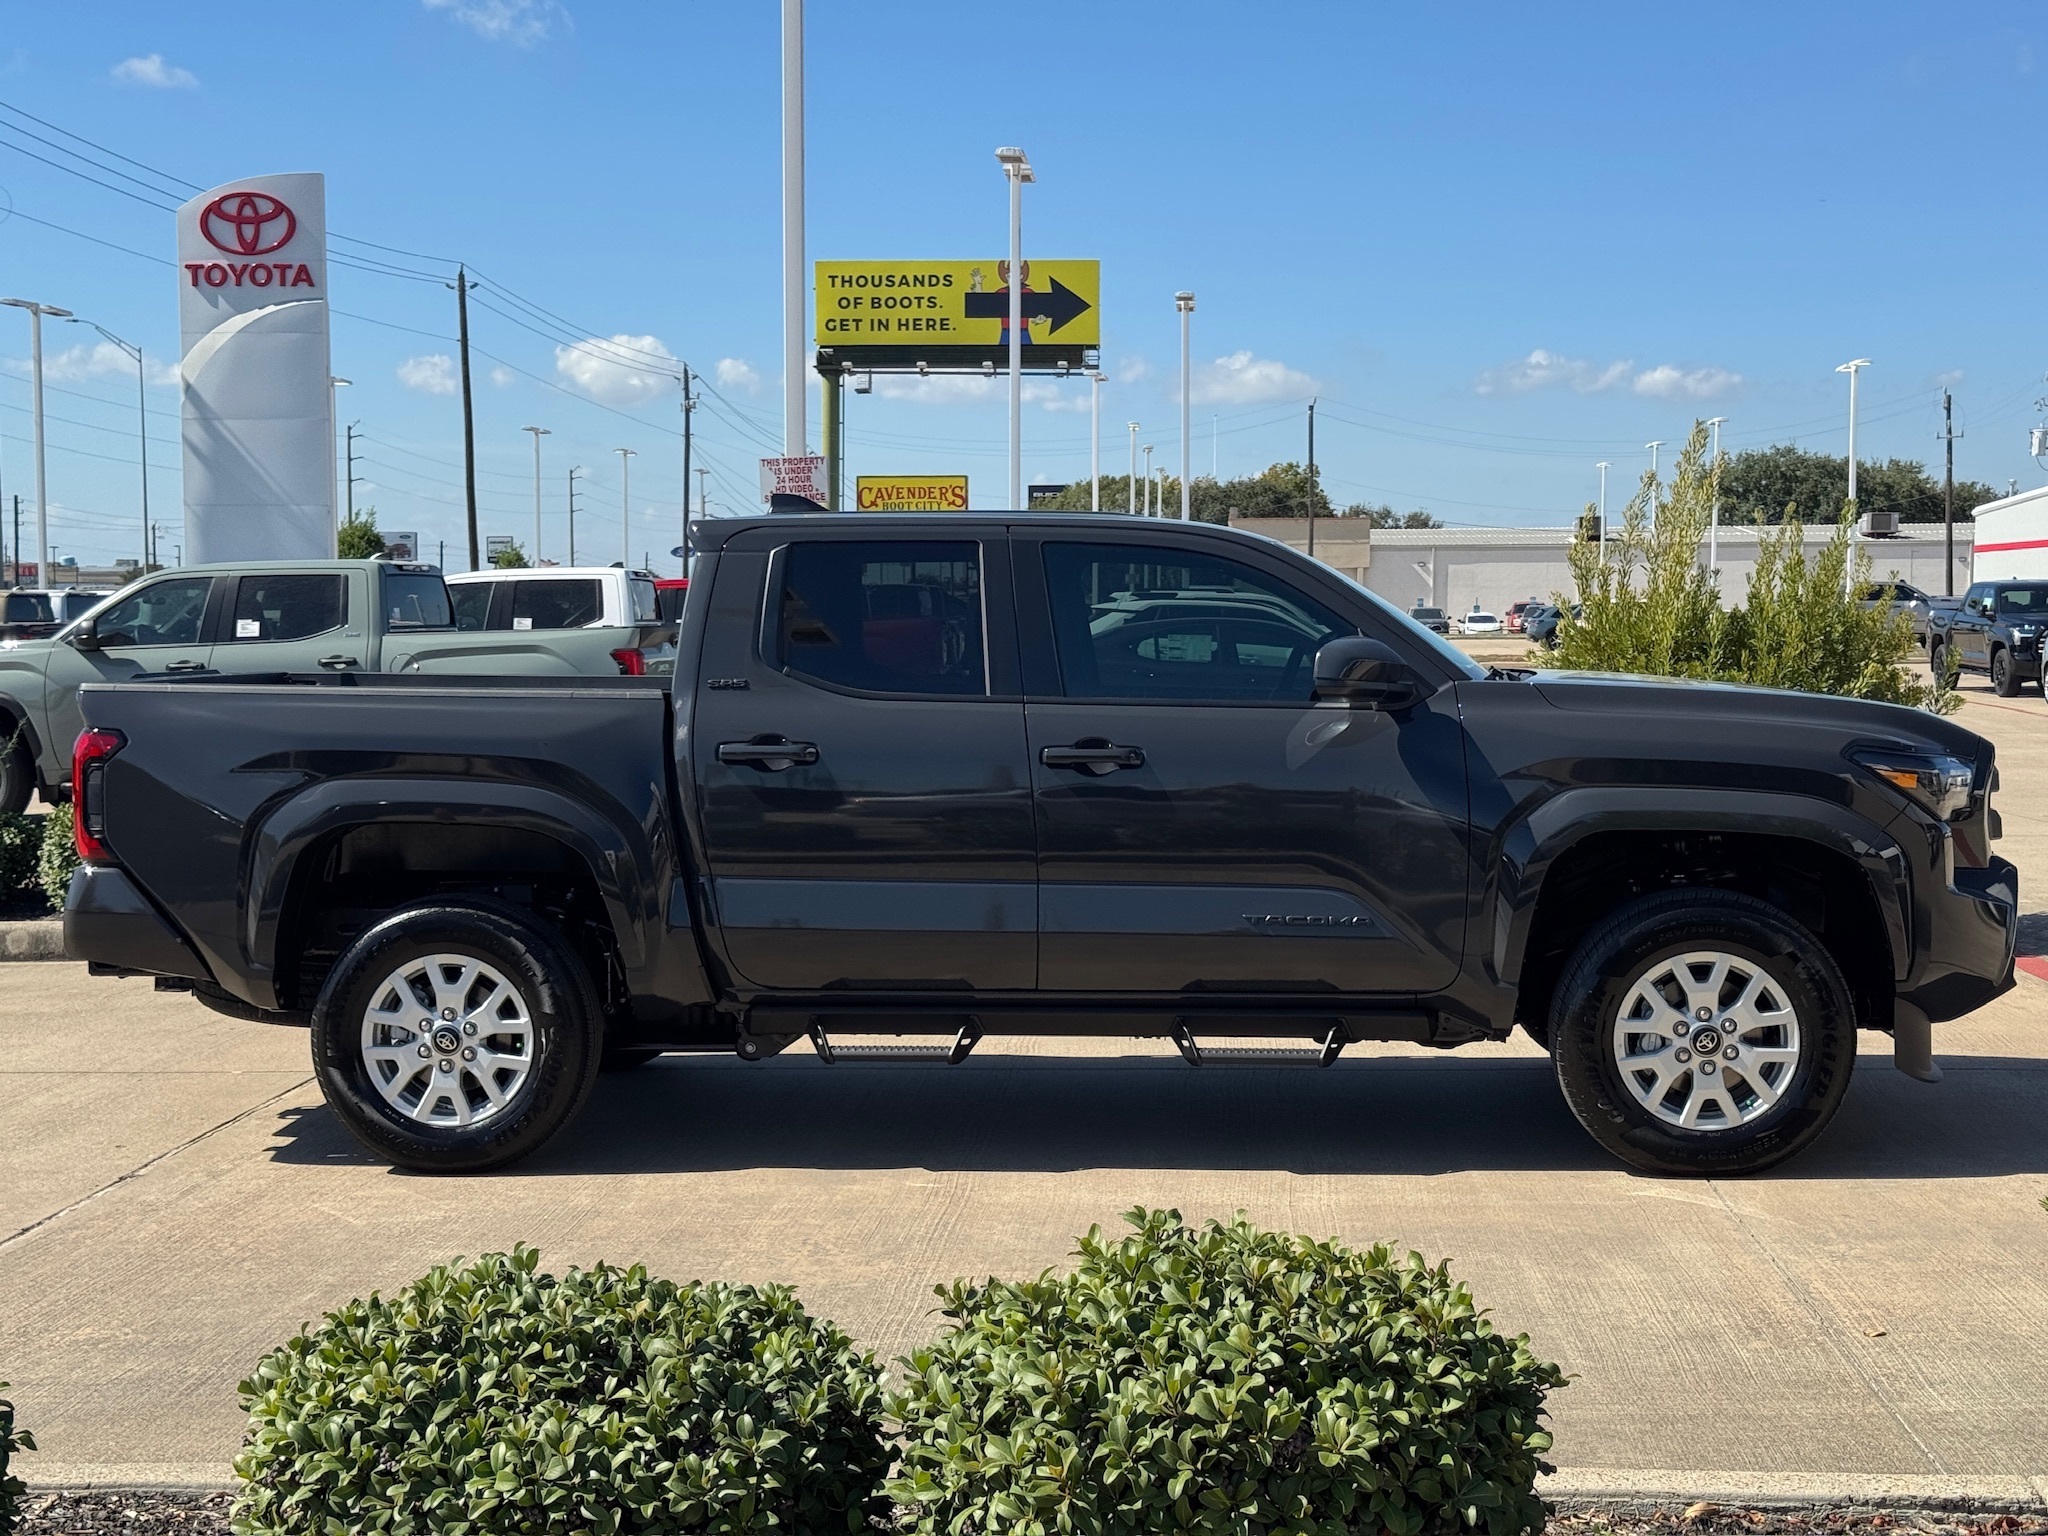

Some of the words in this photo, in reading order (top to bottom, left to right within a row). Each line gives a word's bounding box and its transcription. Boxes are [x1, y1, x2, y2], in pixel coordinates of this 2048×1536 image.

[184, 263, 316, 287] TOYOTA
[828, 274, 954, 288] THOUSANDS
[837, 296, 864, 309] OF
[870, 296, 943, 309] BOOTS.
[825, 318, 863, 331] GET
[870, 318, 890, 331] IN
[897, 318, 957, 331] HERE.
[761, 459, 780, 467] THIS
[782, 457, 825, 466] PROPERTY
[774, 467, 782, 475] IS
[784, 466, 813, 475] UNDER
[776, 476, 786, 485] 24
[788, 475, 812, 484] HOUR
[775, 486, 787, 494] HD
[789, 484, 813, 493] VIDEO
[858, 484, 966, 509] CAVENDER'S
[882, 501, 913, 511] BOOT
[915, 500, 942, 510] CITY
[1242, 914, 1374, 927] TACOMA
